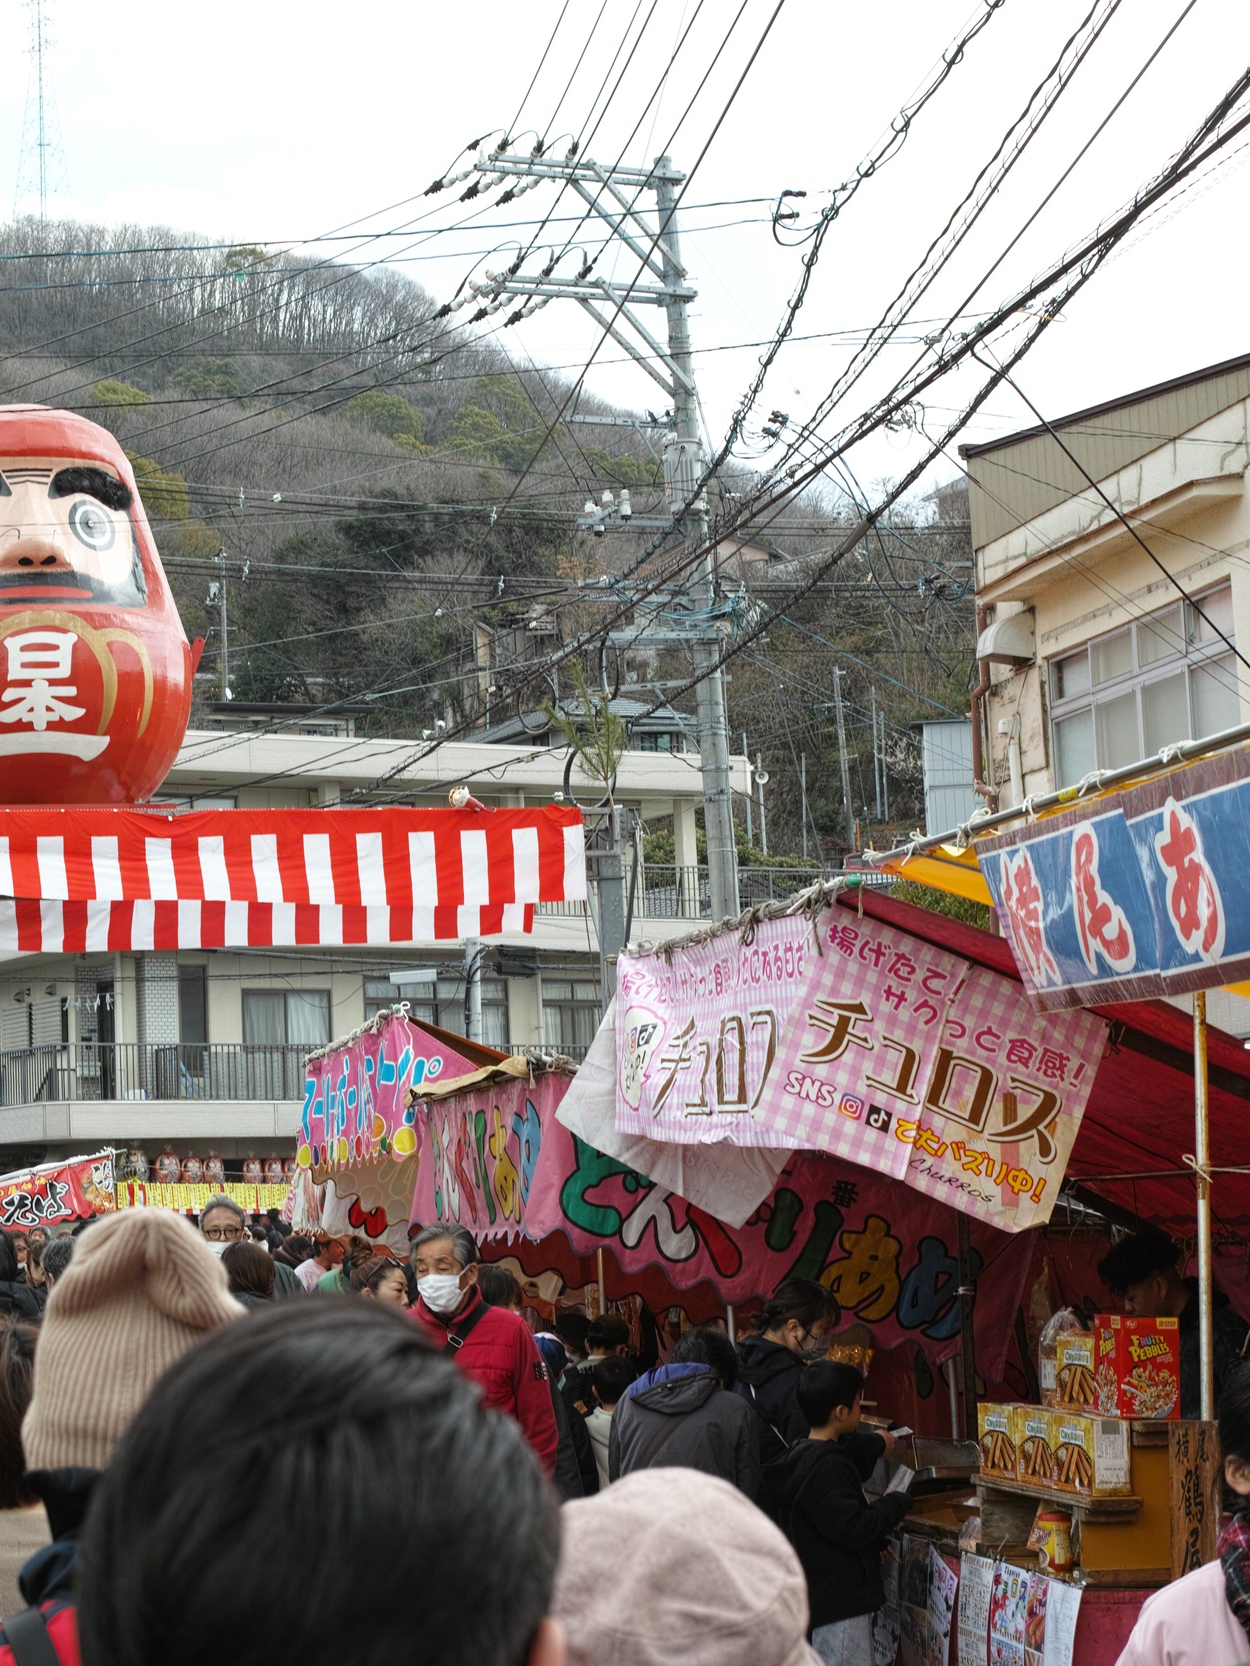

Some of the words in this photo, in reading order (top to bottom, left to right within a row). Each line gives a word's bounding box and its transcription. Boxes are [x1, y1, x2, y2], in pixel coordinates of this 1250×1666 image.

[783, 1071, 836, 1108] SNS
[800, 998, 1063, 1164] チュロス
[1128, 1343, 1170, 1363] PEBBLES
